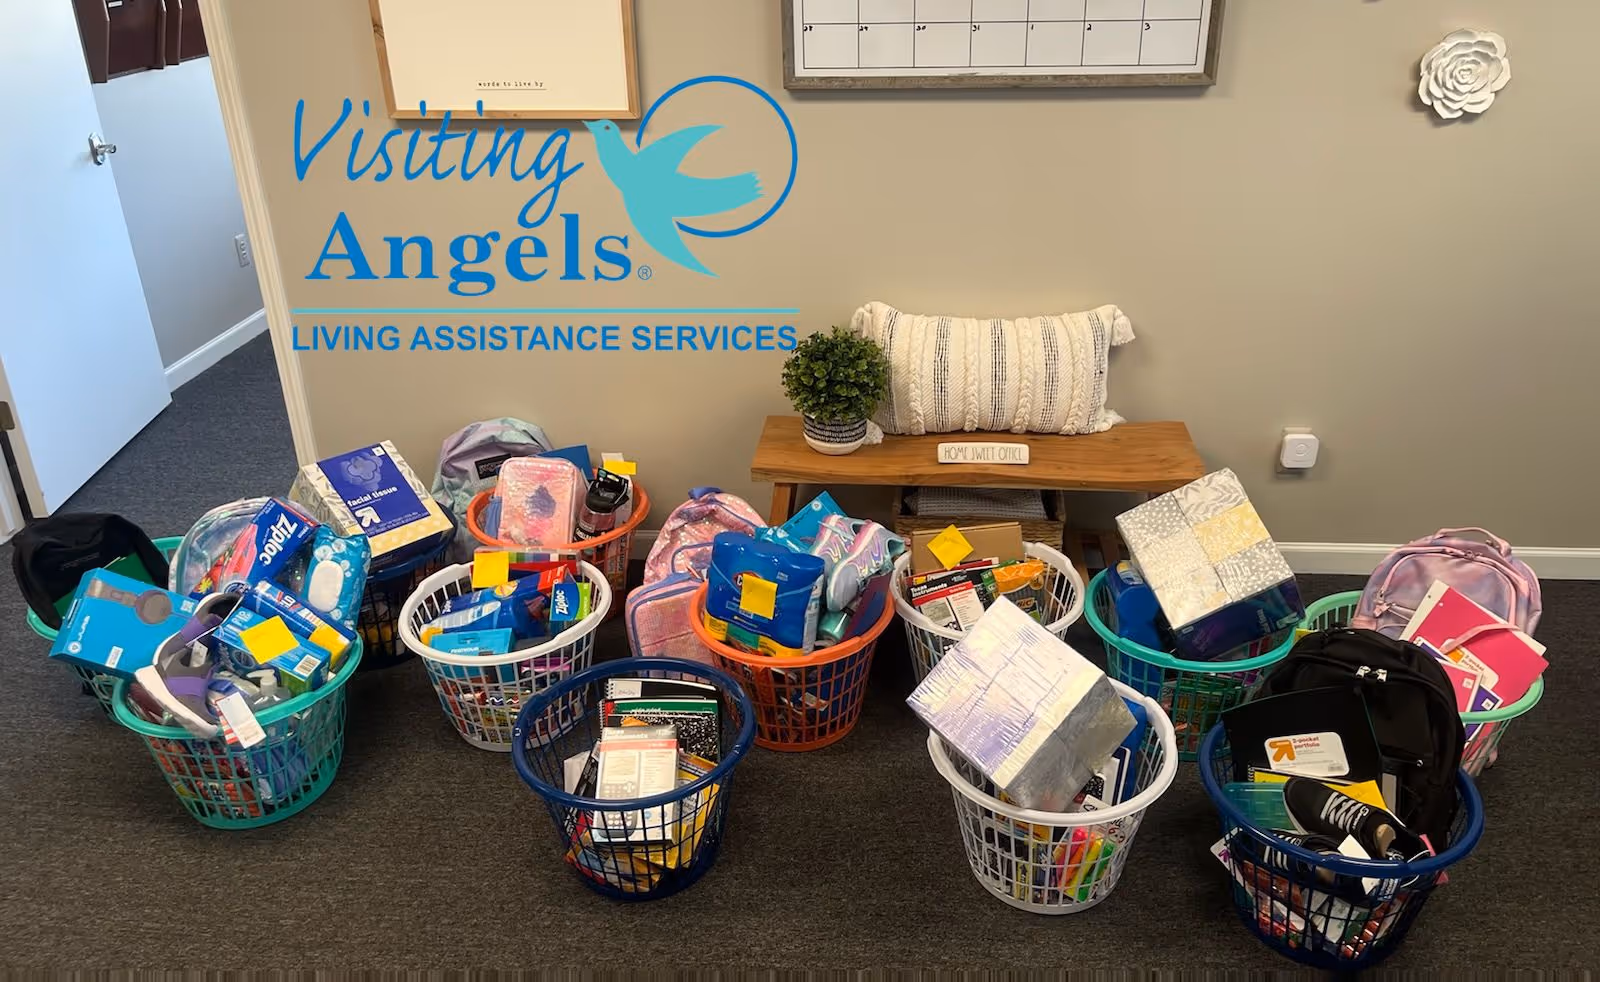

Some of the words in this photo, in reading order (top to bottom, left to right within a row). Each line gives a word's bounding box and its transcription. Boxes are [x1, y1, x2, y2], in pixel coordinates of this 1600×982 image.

[972, 24, 981, 32] 31
[1086, 23, 1092, 31] 2
[1144, 22, 1151, 31] 3
[944, 446, 968, 460] HOME
[971, 446, 995, 460] SWEET
[998, 446, 1023, 461] OFFICE
[346, 494, 373, 508] facial
[372, 486, 398, 499] tissue
[258, 512, 298, 566] Ziploc
[910, 584, 928, 593] Texas
[911, 582, 948, 598] Instruments
[555, 589, 570, 616] Ziploc
[1292, 736, 1320, 744] 2-pocket
[1293, 742, 1321, 750] portfolio
